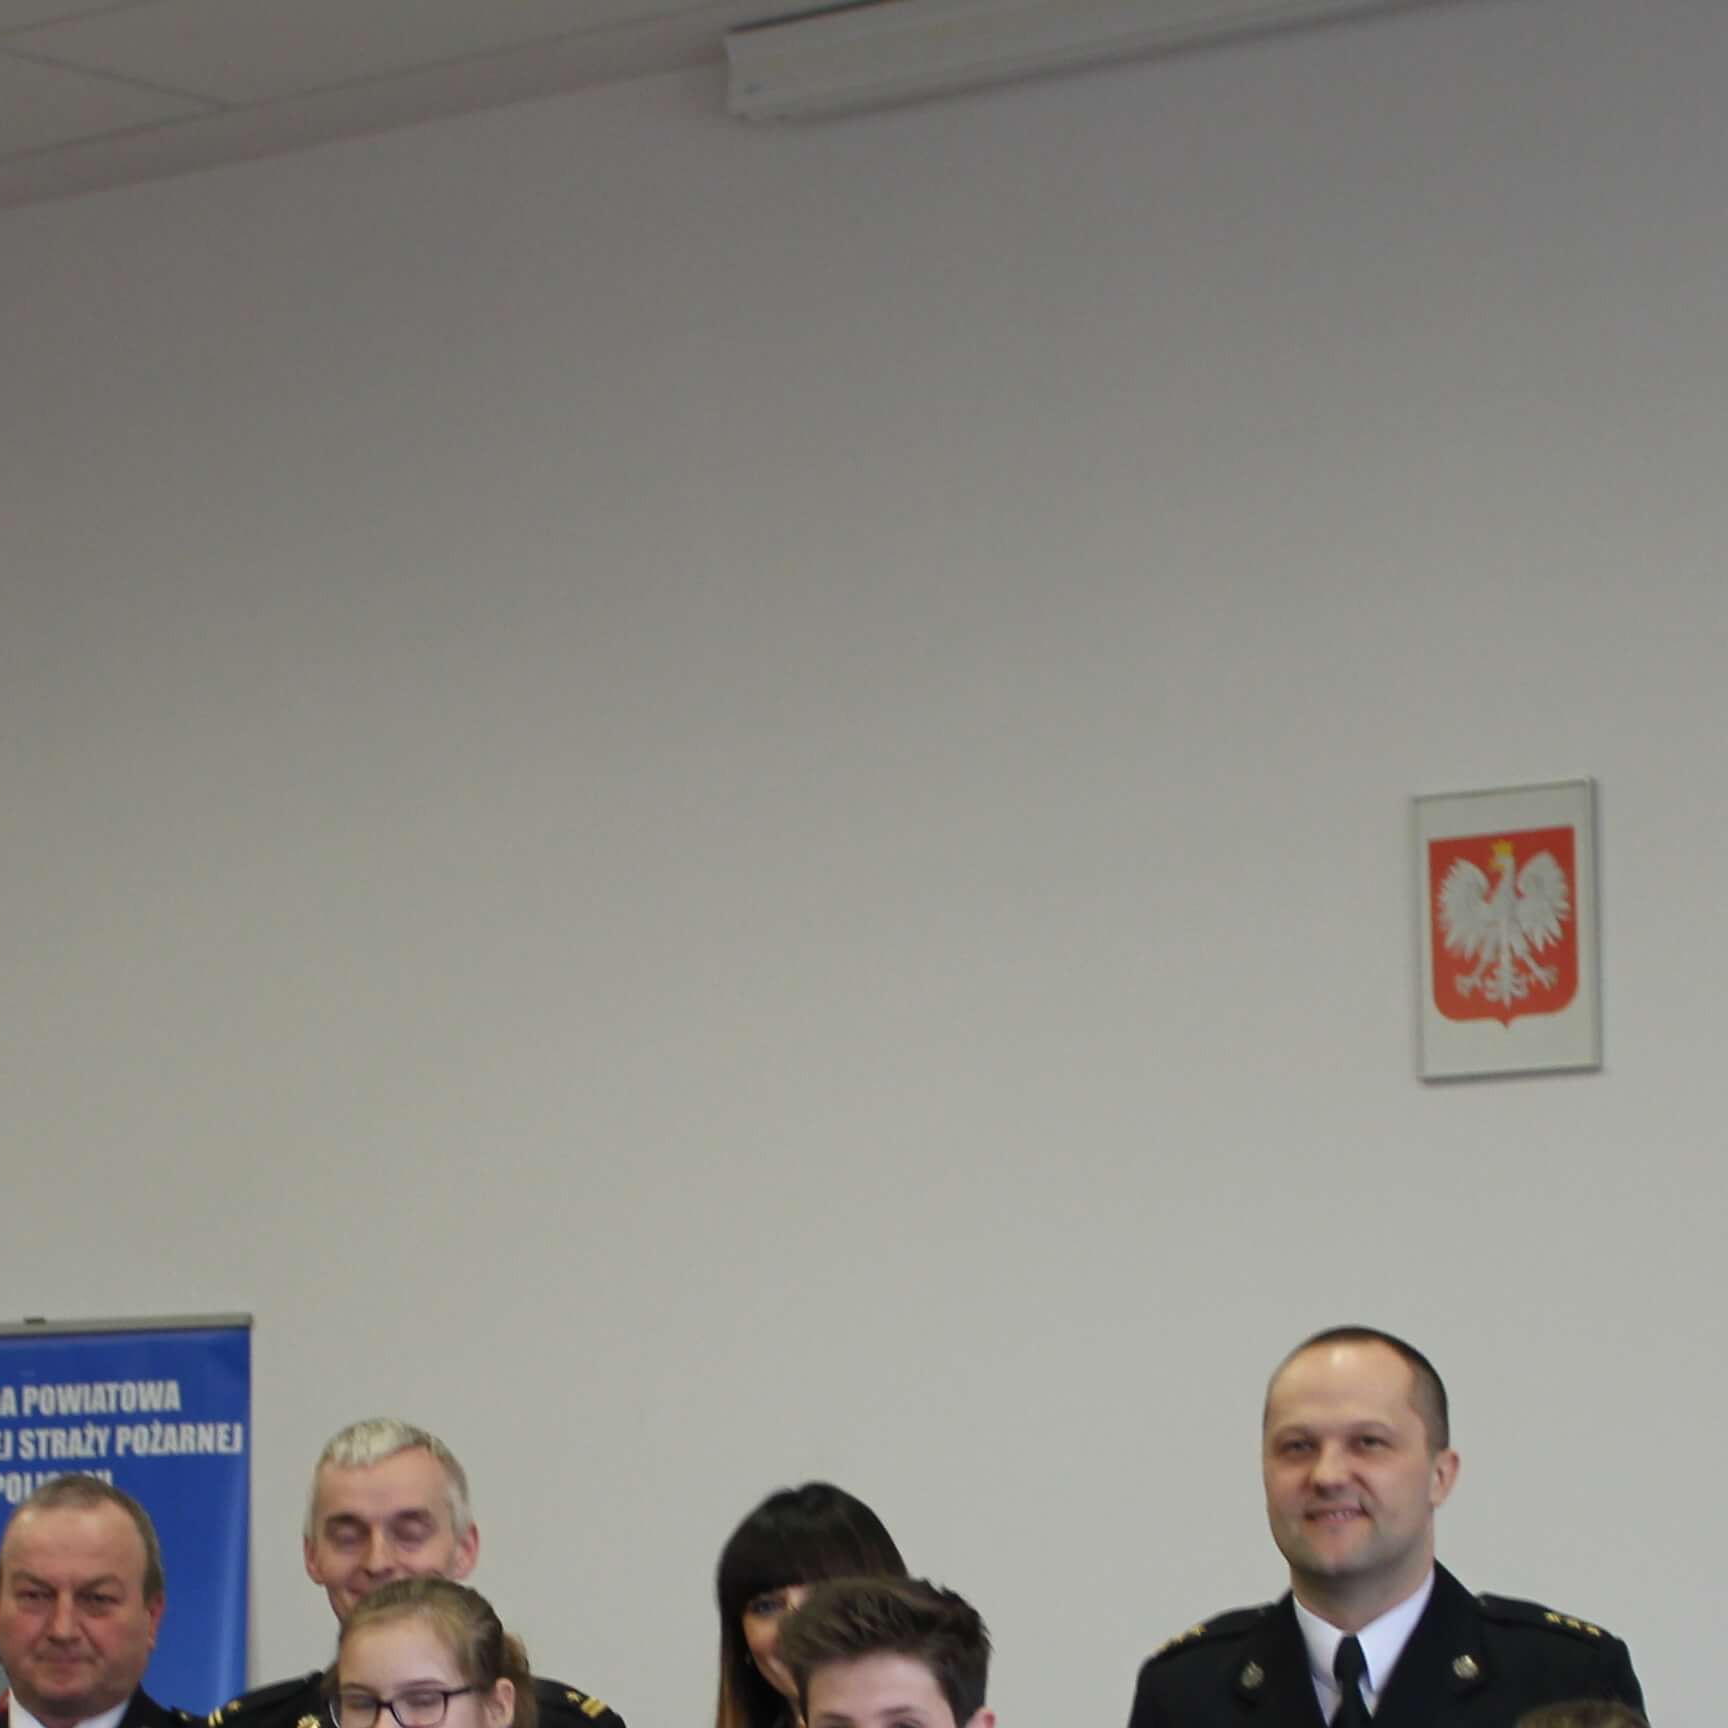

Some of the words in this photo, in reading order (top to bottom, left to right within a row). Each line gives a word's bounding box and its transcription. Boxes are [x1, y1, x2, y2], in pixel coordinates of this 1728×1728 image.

[22, 1380, 181, 1418] POWIATOWA
[18, 1421, 112, 1459] STRAŻY
[116, 1418, 244, 1457] POŻARNEJ
